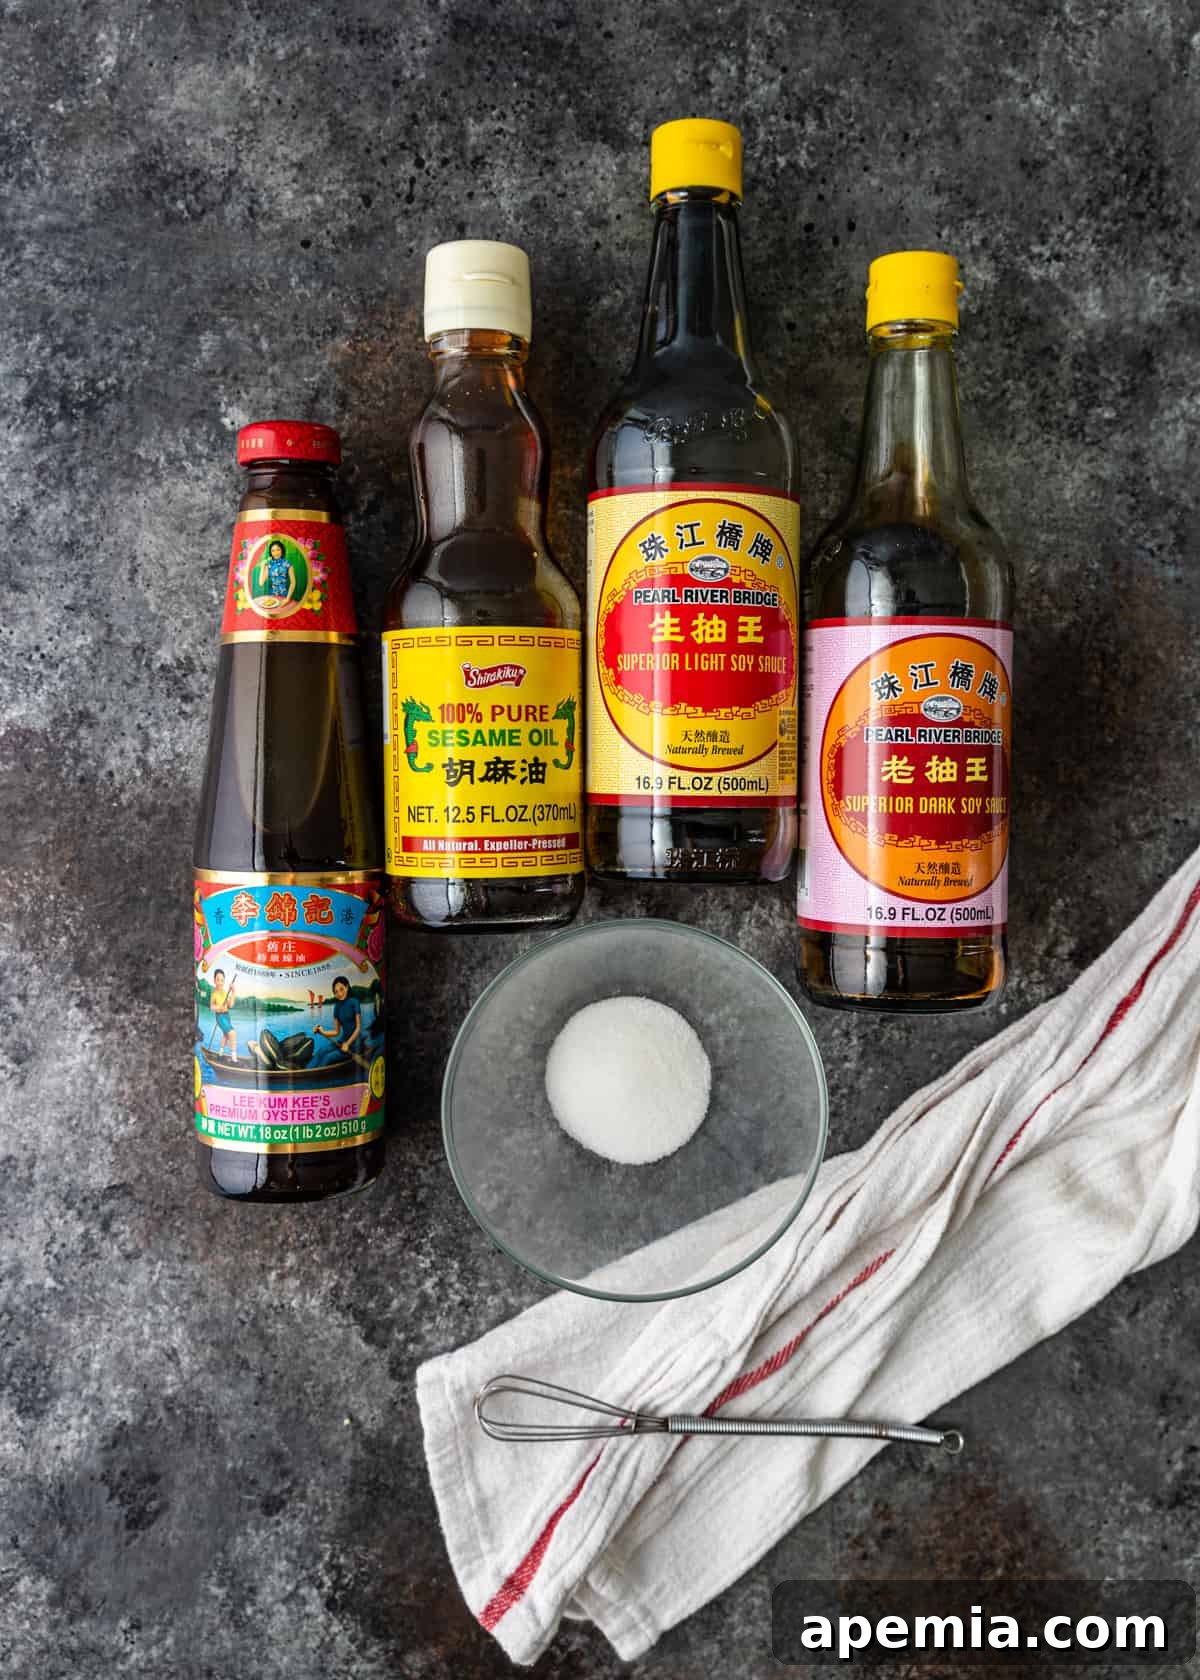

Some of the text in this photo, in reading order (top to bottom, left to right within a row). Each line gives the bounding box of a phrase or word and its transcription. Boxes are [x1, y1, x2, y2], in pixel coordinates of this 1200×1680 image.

[638, 520, 776, 565] 珠江橋牌
[634, 588, 778, 606] PEARL RIVER BRIDGE
[648, 610, 765, 644] 生抽王
[617, 653, 787, 674] SUPERIOR LIGHT SOY SAUCE
[468, 664, 518, 687] Shirakiku
[870, 660, 1000, 703] 珠江橋牌
[438, 703, 550, 724] 100% PURE
[427, 728, 559, 748] SESAME OIL
[864, 728, 1002, 744] PEARL RIVER BRIDGE
[665, 744, 744, 757] Naturally Brewed
[442, 757, 547, 787] 胡麻油
[881, 756, 988, 784] 老抽王
[635, 776, 769, 793] 16.9 FL.OZ (500mL)
[846, 796, 1007, 814] SUPERIOR DARK SOY SAUCE
[407, 806, 438, 824] NET.
[444, 806, 476, 824] 12.5
[423, 839, 435, 850] All
[484, 837, 566, 850] Expeller-Pressed
[897, 876, 972, 888] Naturally Brewed
[230, 891, 334, 927] 李錦記
[867, 906, 994, 924] 16.9 FL.OZ (500mL)
[232, 1094, 330, 1109] LEE KUM KEE'S
[209, 1104, 358, 1122] PREMIUM OYSTER SAUCE
[218, 1121, 236, 1137] NET
[238, 1123, 256, 1139] WT.
[258, 1126, 271, 1140] 18
[274, 1130, 288, 1140] oz
[302, 1126, 313, 1139] lb
[315, 1125, 322, 1138] 2
[324, 1124, 340, 1138] oz)
[342, 1120, 358, 1135] 510
